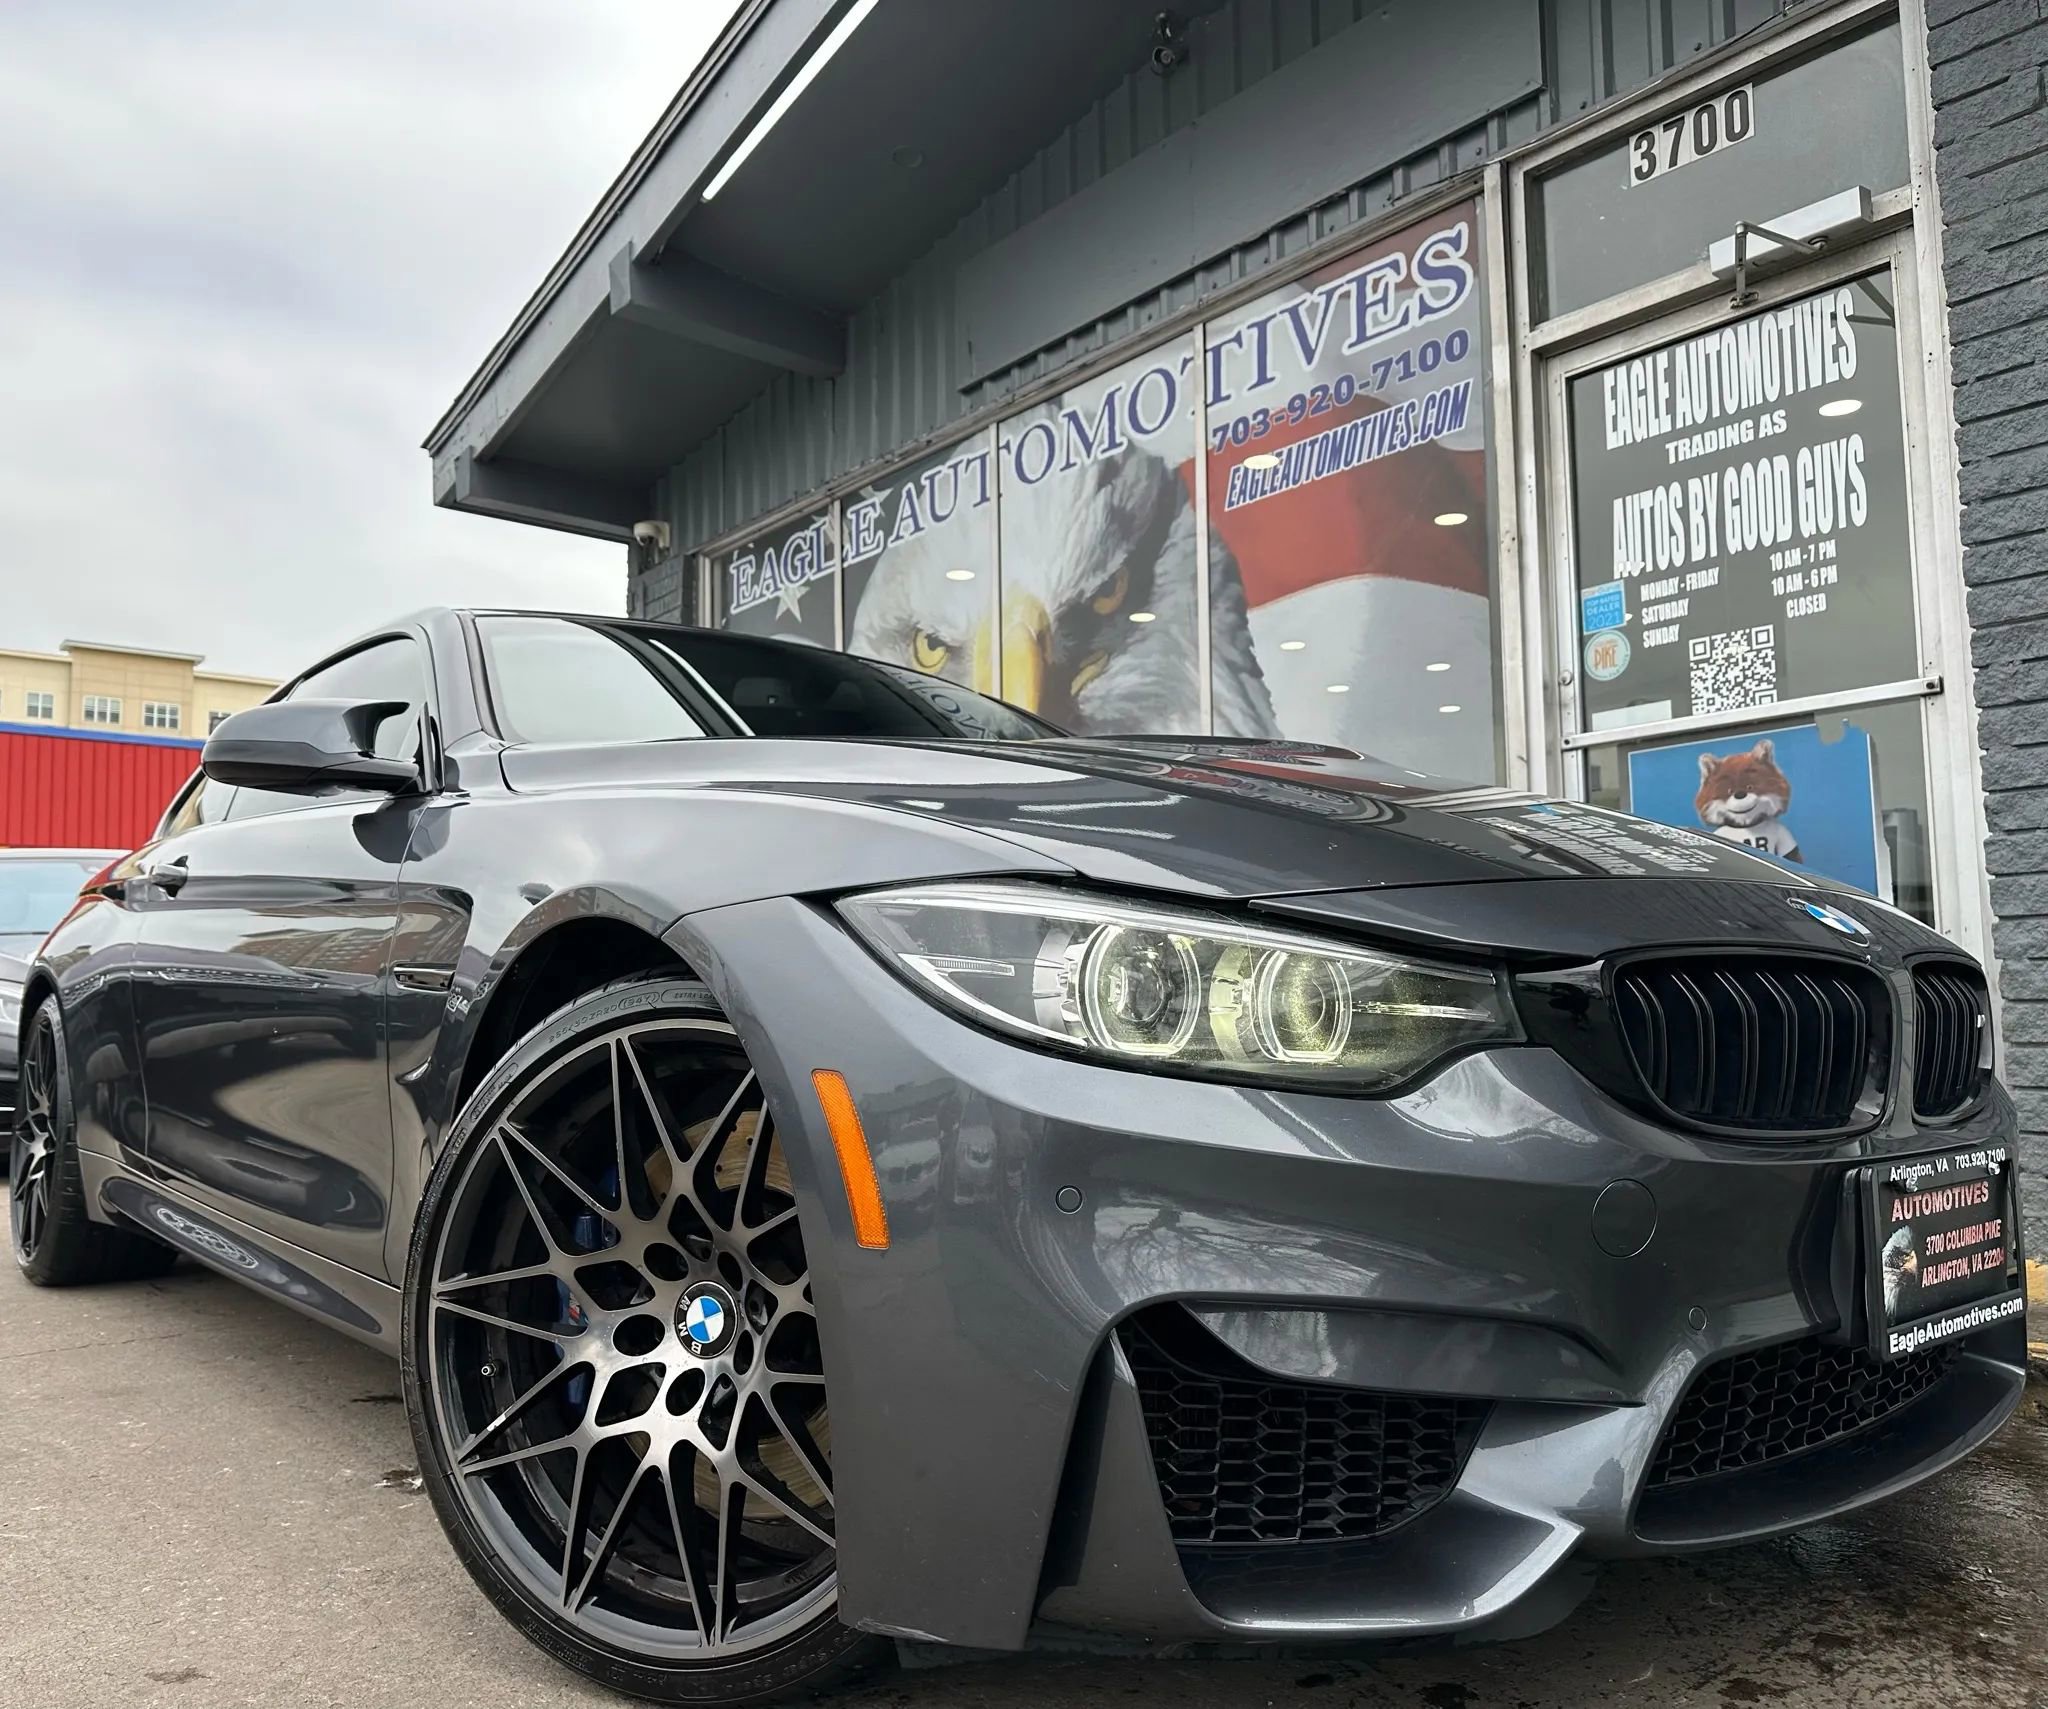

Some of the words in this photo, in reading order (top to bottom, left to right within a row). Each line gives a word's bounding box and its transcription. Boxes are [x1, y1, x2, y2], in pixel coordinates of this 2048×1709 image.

[1633, 88, 1750, 183] 3700
[1603, 350, 1672, 451] EAGLE
[1675, 288, 1857, 430] AUTOMOTIVES
[1212, 328, 1470, 456] 703-920-7100
[730, 500, 885, 616] EAGLE
[887, 222, 1474, 547] AUTOMOTIVES
[1665, 419, 1754, 465] TRADING
[1758, 409, 1788, 438] AS
[1224, 379, 1473, 512] EAGLEAUTOMOTIVES.COM
[1612, 481, 1686, 579] AUTOS
[1687, 471, 1719, 562] BY
[1723, 454, 1793, 555] GOOD
[1796, 433, 1868, 538] GUYS
[1769, 551, 1784, 571] 10
[1784, 547, 1802, 568] AM
[1808, 544, 1815, 563] 7
[1818, 539, 1836, 560] PM
[1640, 576, 1680, 602] MONDAY
[1686, 566, 1720, 592] FRIDAY
[1771, 576, 1785, 596] 10
[1785, 572, 1803, 593] AM
[1810, 569, 1819, 588] 6
[1820, 564, 1838, 585] PM
[1586, 602, 1621, 616] DEALER
[1589, 611, 1621, 629] 2021
[1641, 598, 1690, 625] SATURDAY
[1786, 592, 1827, 618] CLOSED
[1643, 623, 1680, 648] SUNDAY
[1889, 1162, 1935, 1183] Arlington,
[1935, 1158, 1949, 1173] VA
[1955, 1147, 2006, 1170] 703.920.7100
[1891, 1181, 1989, 1222] AUTOMOTIVES
[1925, 1235, 1944, 1256] 3700
[1945, 1224, 1984, 1251] COLUMBIA
[1984, 1218, 2002, 1240] PIKE
[1921, 1256, 1970, 1288] ARLINGTON,
[1971, 1253, 1983, 1273] VA
[1888, 1296, 2024, 1354] EagleAutomotives.com
